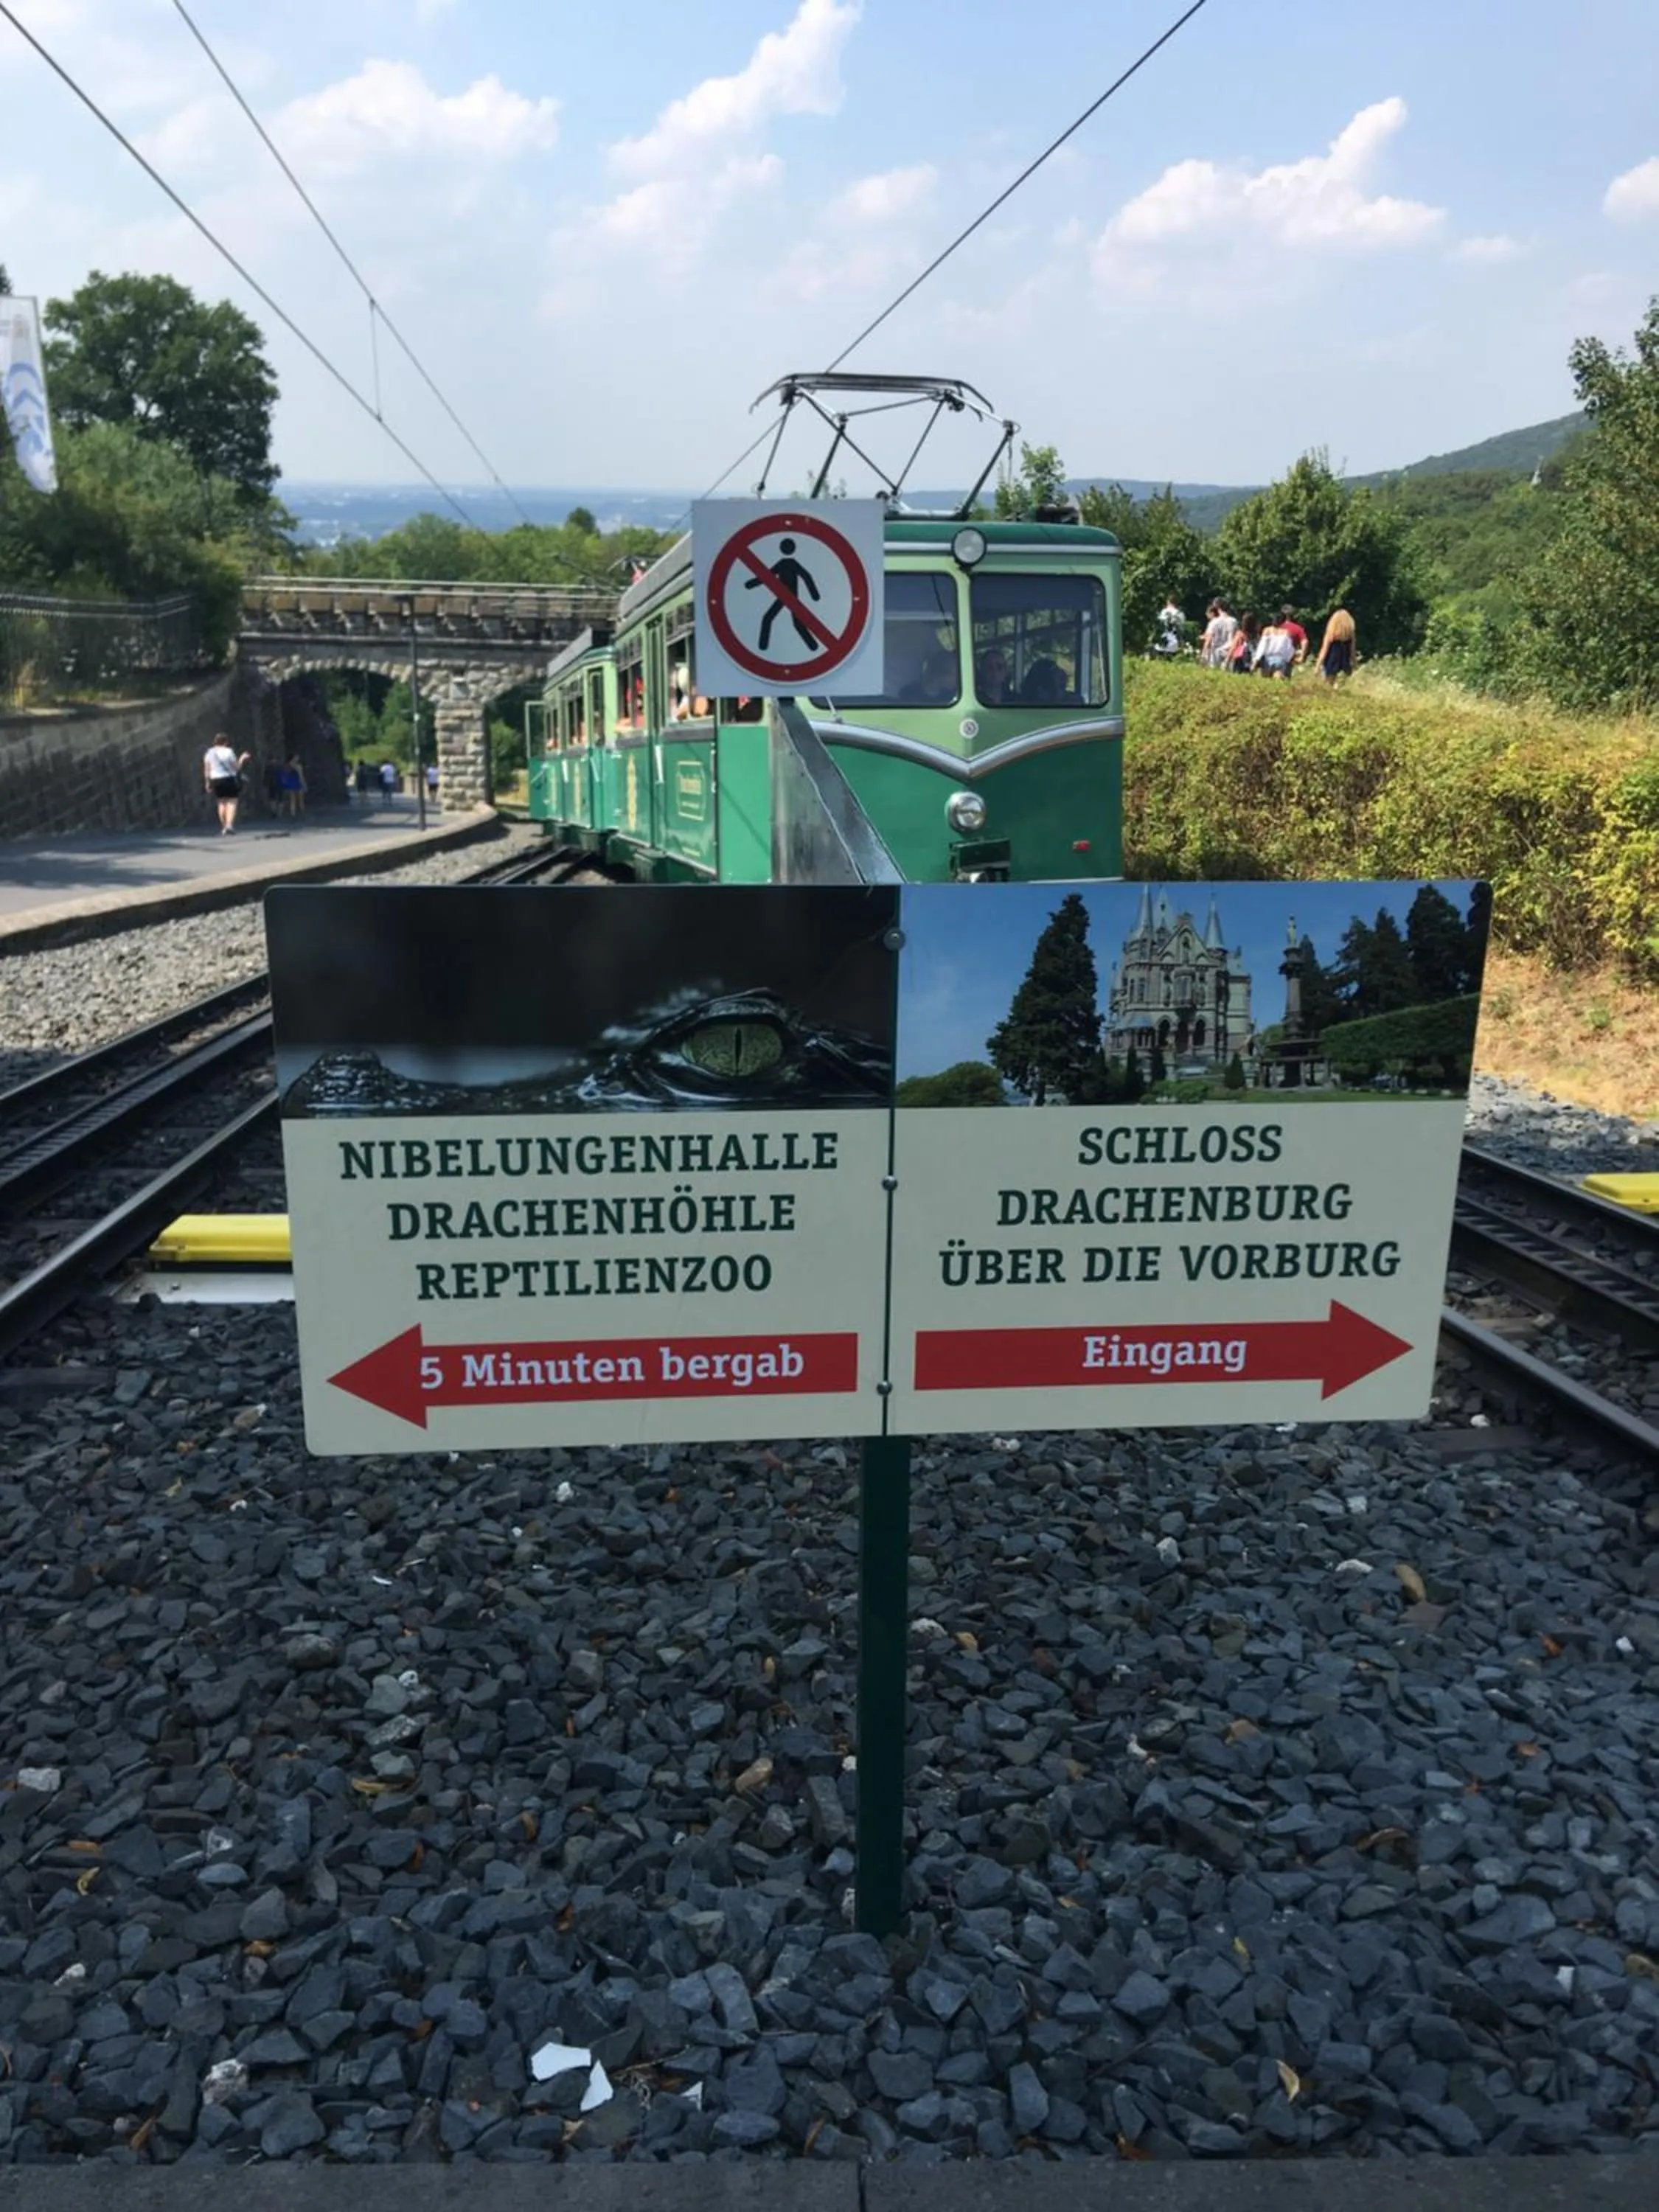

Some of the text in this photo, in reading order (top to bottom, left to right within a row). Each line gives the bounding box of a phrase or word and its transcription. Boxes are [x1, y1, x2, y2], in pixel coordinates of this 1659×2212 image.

[339, 1133, 838, 1180] NIBELUNGENHALLE
[1079, 1125, 1281, 1165] SCHLOSS
[387, 1185, 795, 1240] DRACHENHÖHLE
[997, 1183, 1352, 1225] DRACHENBURG
[416, 1254, 771, 1300] REPTILIENZOO
[939, 1239, 1400, 1287] ÜBER DIE VORBURG
[420, 1343, 804, 1389] 5 Minuten bergab
[1083, 1335, 1247, 1374] Eingang
